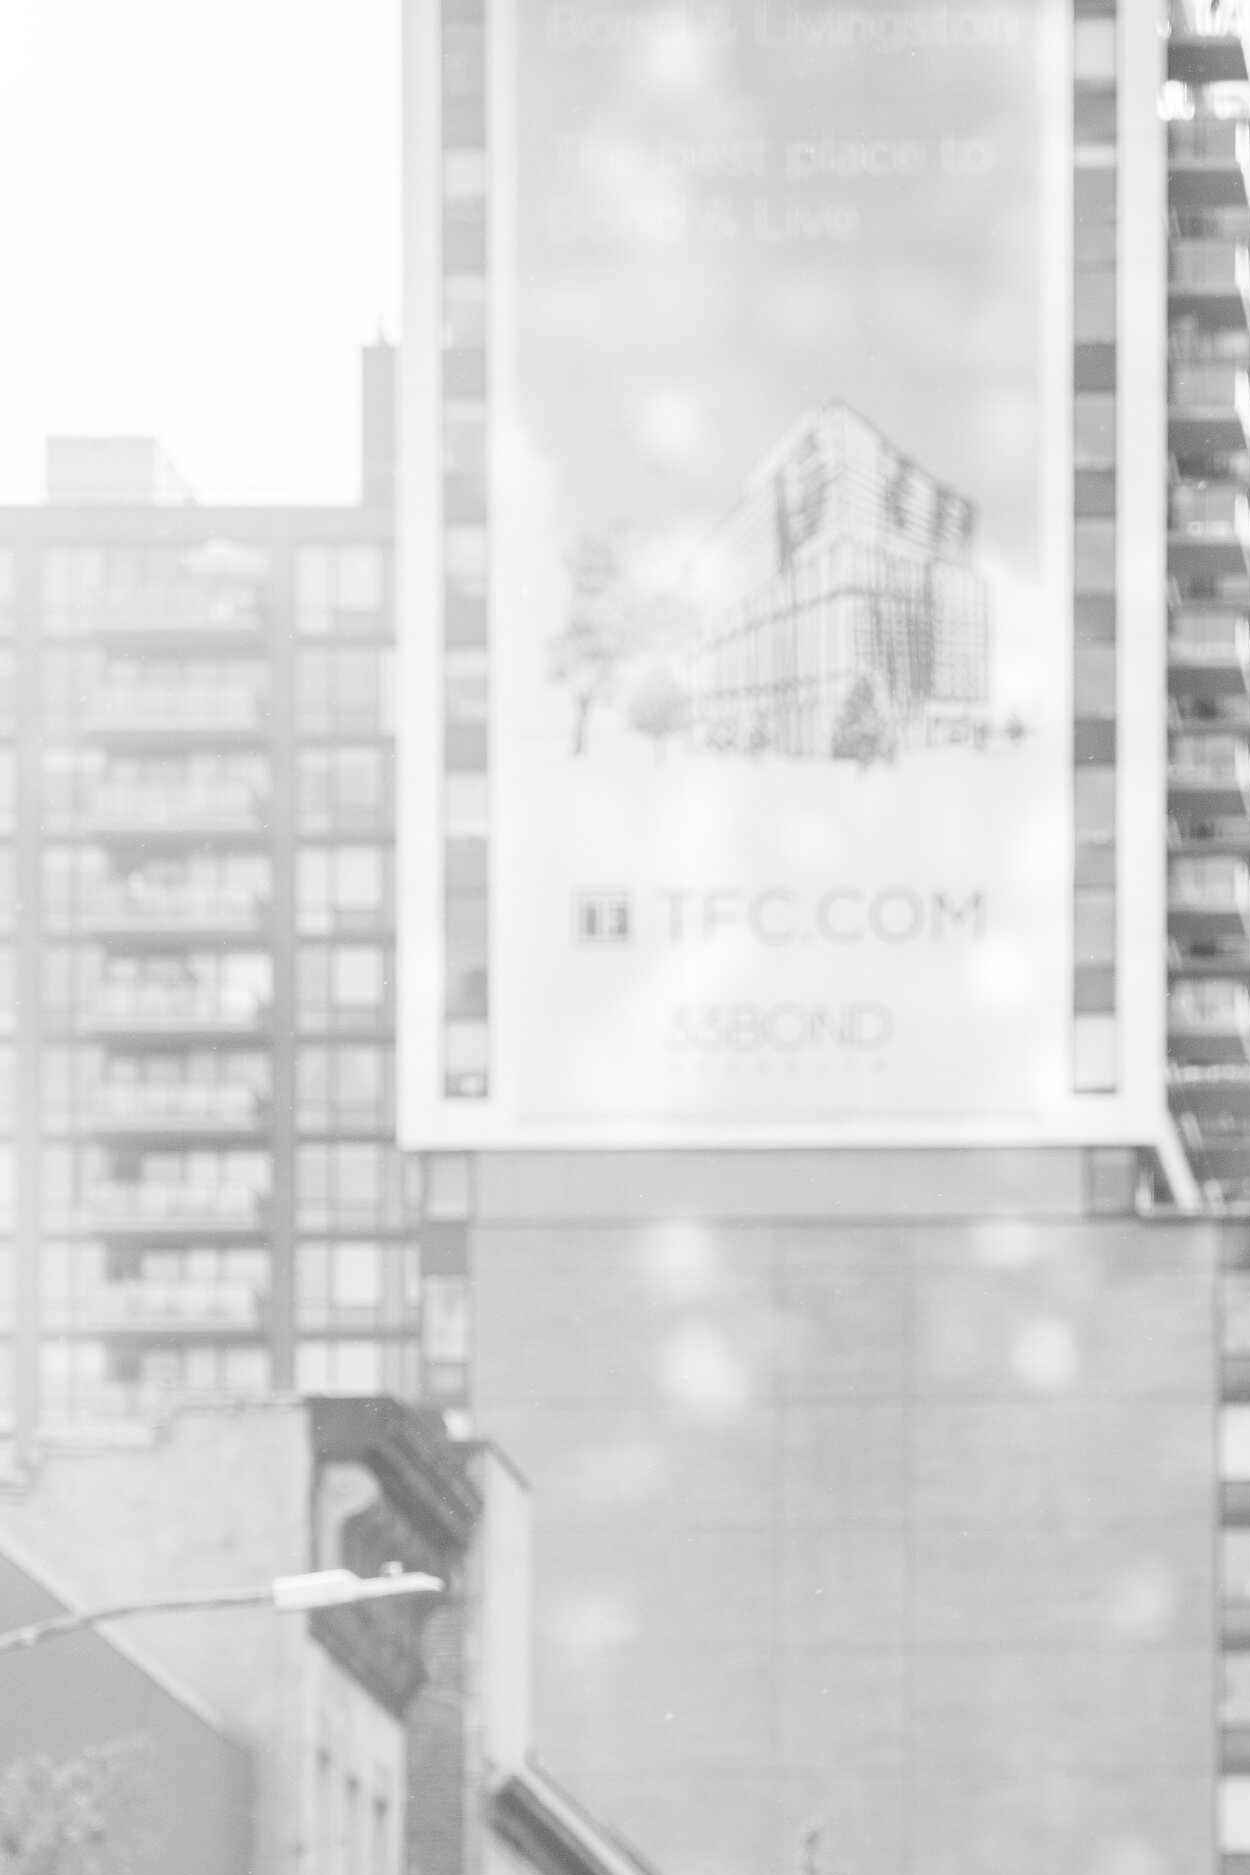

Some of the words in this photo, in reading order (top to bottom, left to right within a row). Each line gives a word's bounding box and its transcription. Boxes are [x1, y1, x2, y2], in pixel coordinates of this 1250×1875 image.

[753, 3, 1021, 54] Livingston
[785, 128, 927, 184] place
[939, 133, 997, 177] to
[753, 194, 862, 242] Live
[654, 884, 989, 947] TFC.COM
